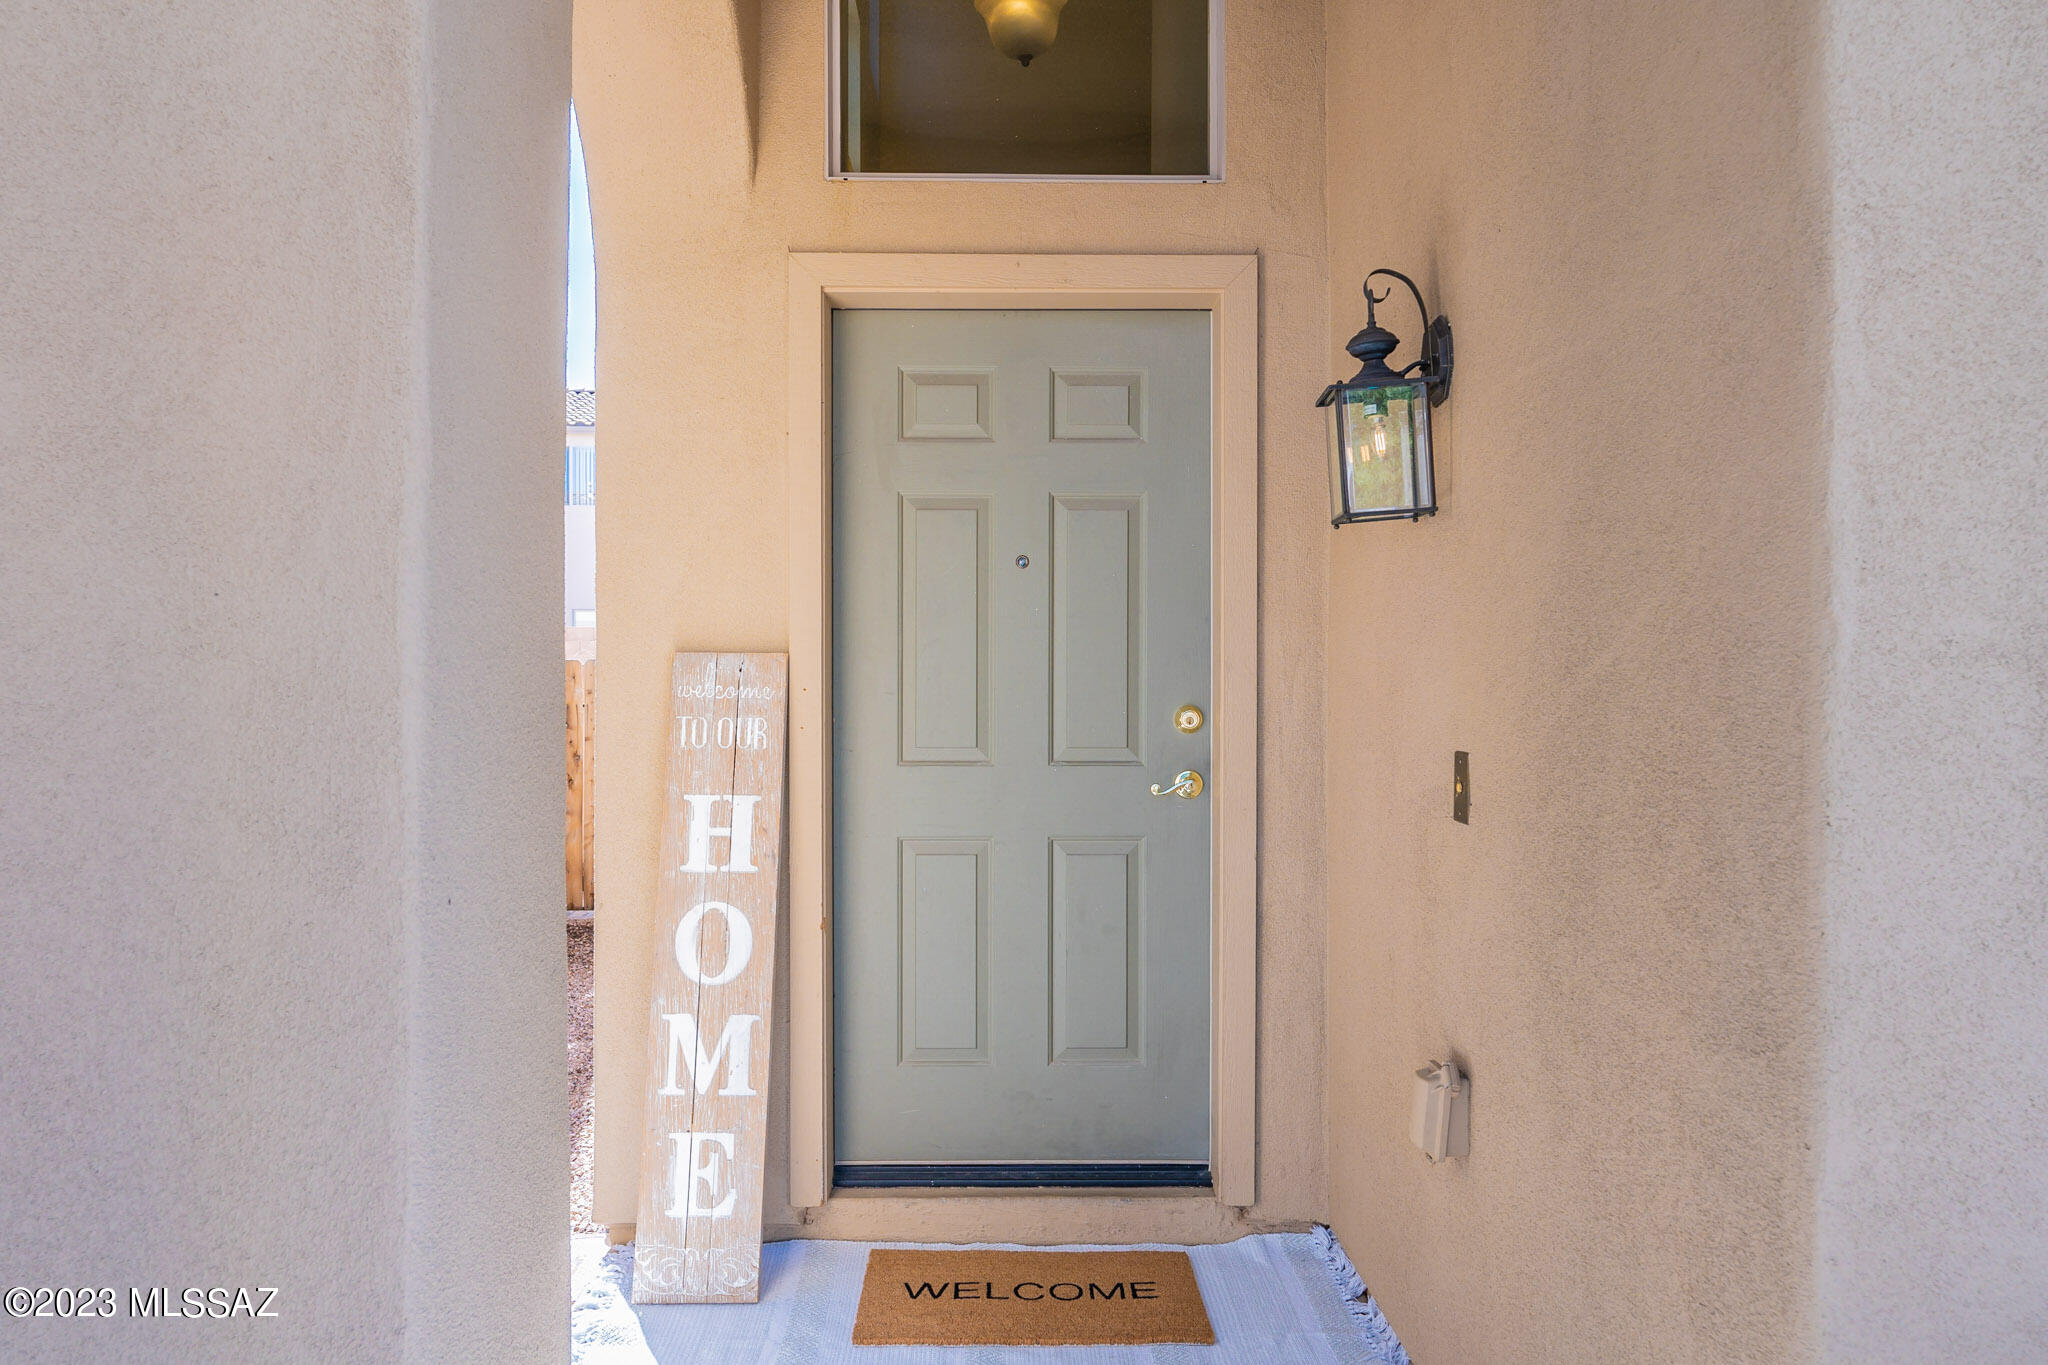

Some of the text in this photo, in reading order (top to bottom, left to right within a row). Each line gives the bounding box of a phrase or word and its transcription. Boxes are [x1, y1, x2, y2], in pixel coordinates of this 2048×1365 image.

[677, 662, 776, 700] welcome
[676, 716, 768, 750] TO OUR
[657, 794, 763, 1219] HOME
[904, 1281, 1159, 1301] WELCOME
